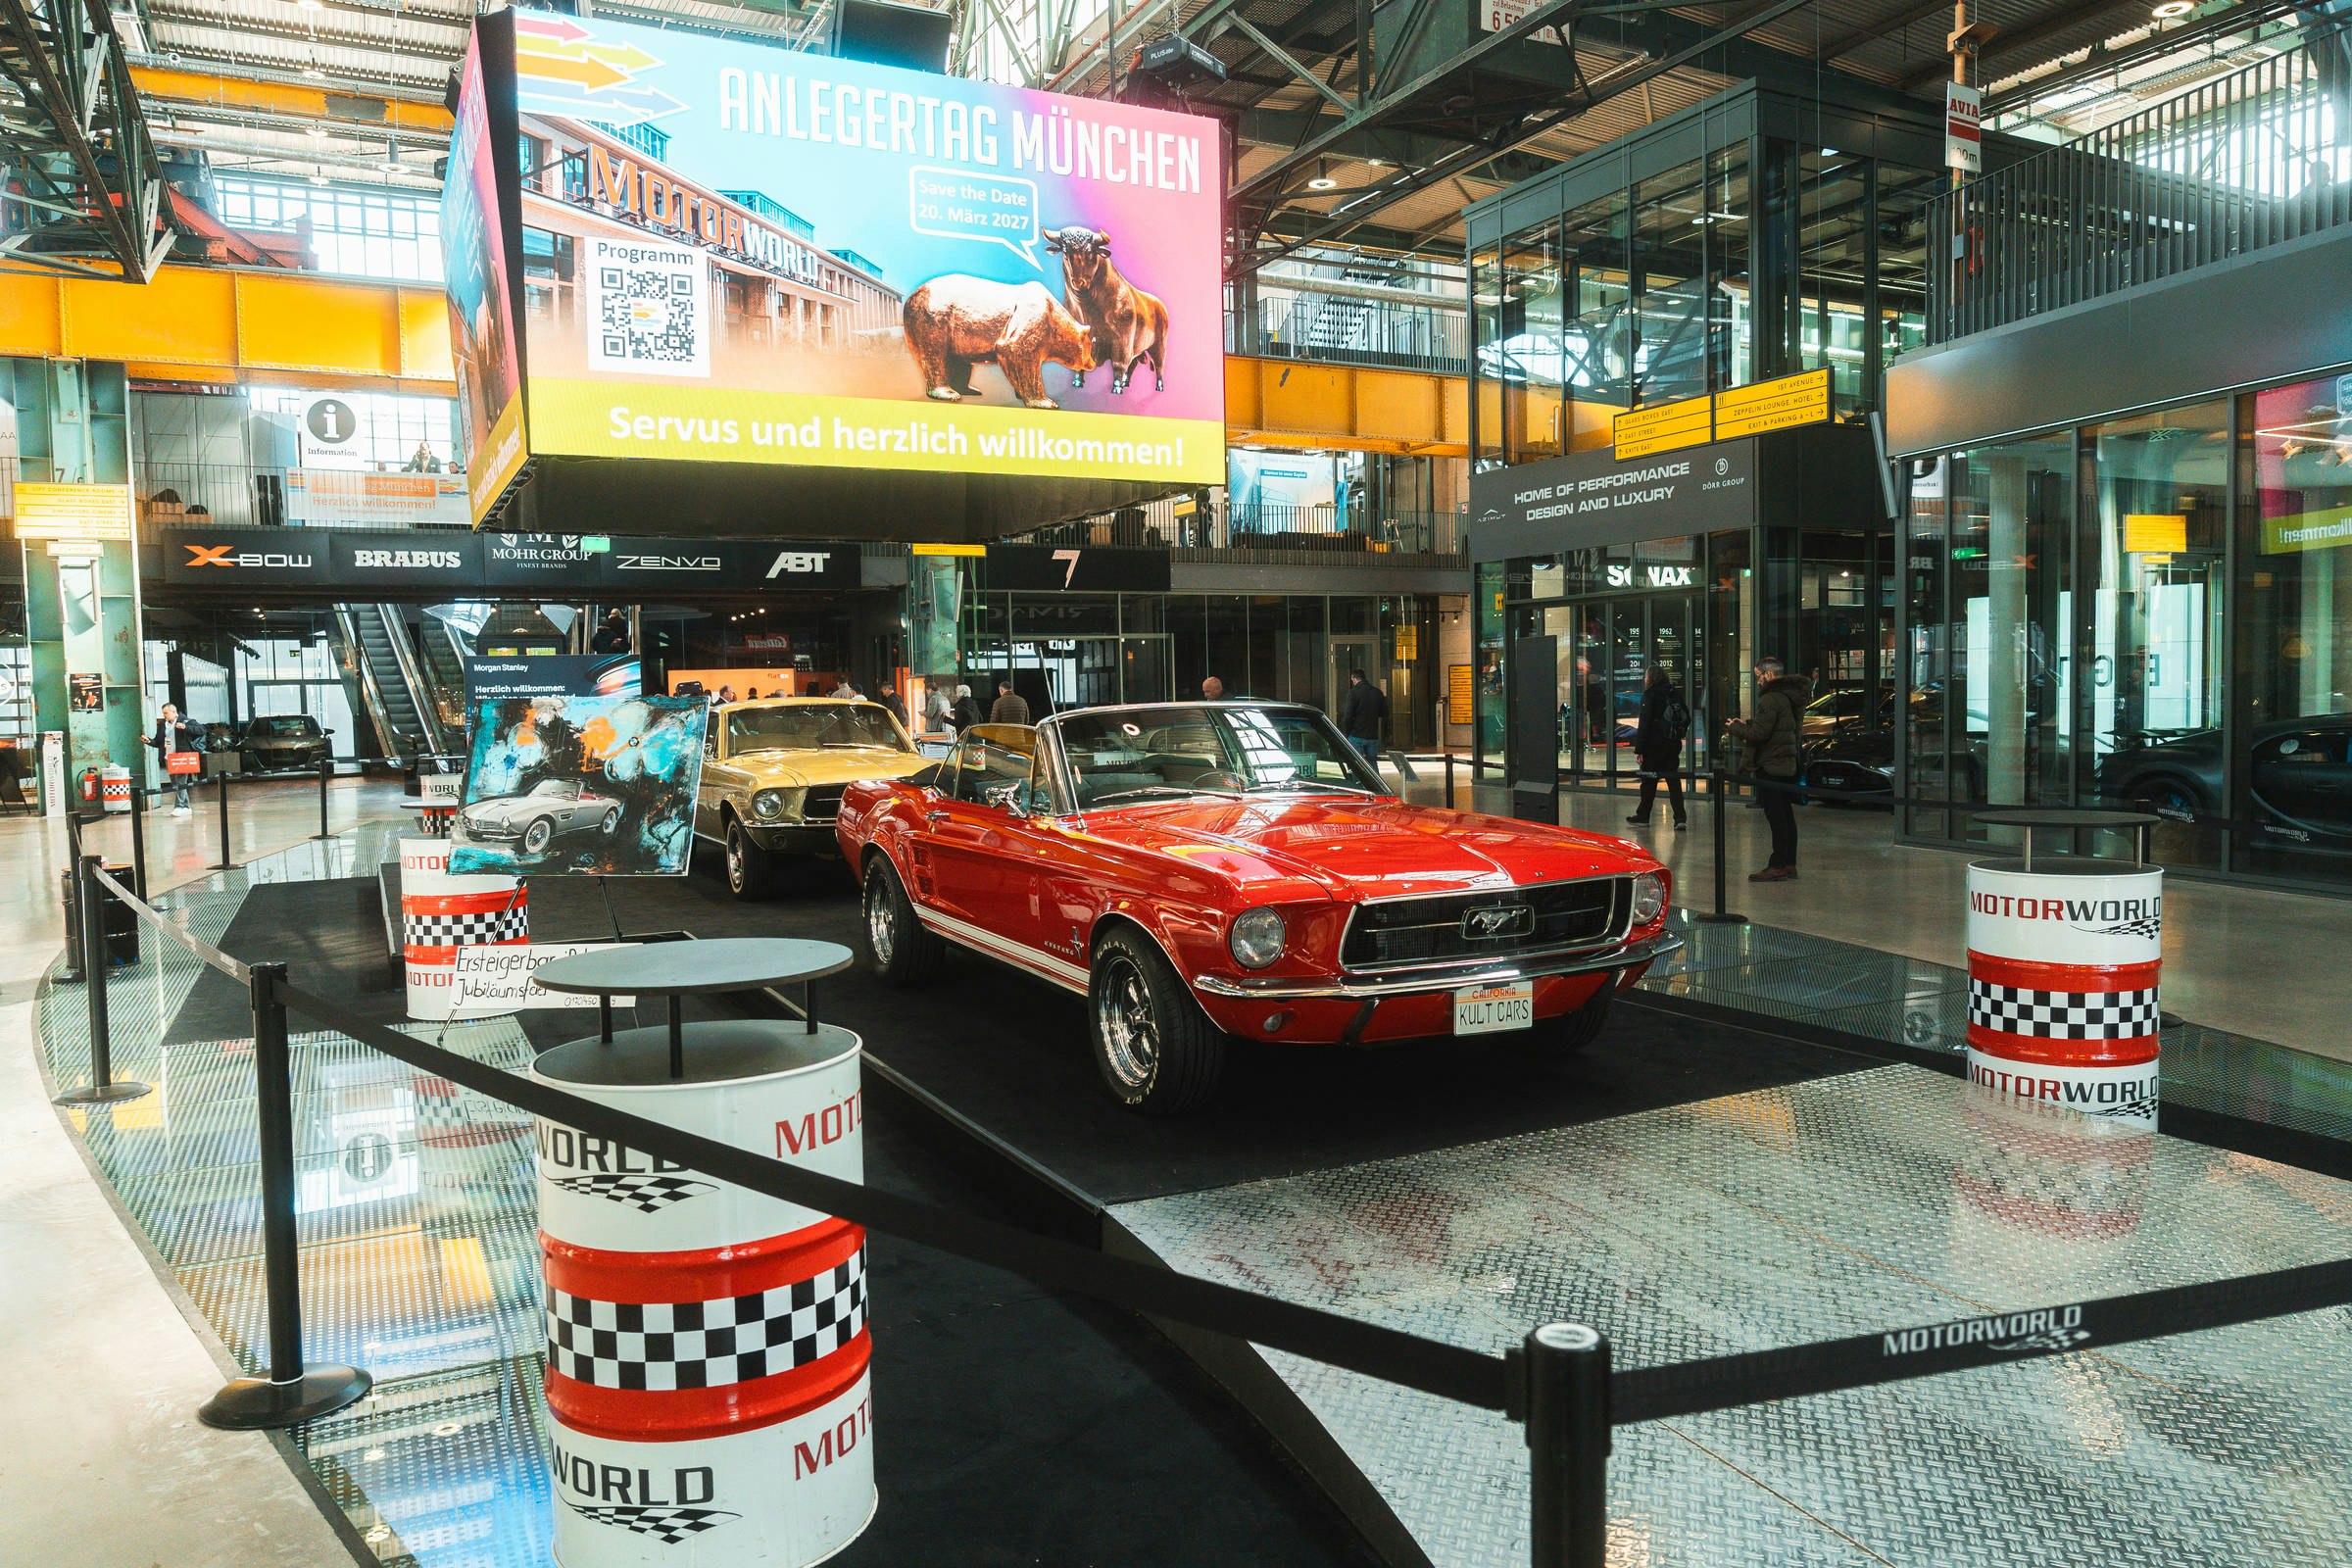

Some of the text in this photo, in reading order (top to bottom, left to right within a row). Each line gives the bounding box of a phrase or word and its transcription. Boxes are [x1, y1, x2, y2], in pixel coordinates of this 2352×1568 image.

[1949, 98, 1980, 118] AVIA
[718, 66, 1201, 194] ANLEGERTAG MÜNCHEN
[918, 178, 1028, 207] Save the Date
[588, 142, 817, 280] MOTORWORLD
[917, 203, 1030, 229] 20. März 2027
[597, 241, 694, 267] Programm
[1778, 377, 1814, 391] 1ST AVENUE
[1734, 406, 1762, 416] ZEPPELIN
[1793, 395, 1814, 405] HOTEL
[1748, 419, 1762, 430] EXIT
[1770, 413, 1797, 425] PARKING
[609, 406, 1184, 467] Servus und herzlich willkommen!
[308, 447, 358, 458] Information
[1514, 462, 1690, 505] HOME OF PERFORMANCE
[1722, 477, 1745, 487] GROUP
[312, 496, 437, 510] Herzlich willkommen!
[1526, 485, 1676, 521] DESIGN AND LUXURY
[354, 550, 462, 568] BRABUS
[492, 548, 593, 562] MOHR GROUP
[615, 555, 721, 570] ZENVO
[765, 552, 831, 578] ABT
[473, 663, 528, 673] Morgan Stanley
[474, 685, 512, 694] Herzlich
[1970, 891, 2161, 921] MOTORWORLD
[1471, 987, 1517, 1000] CALIFORNIA
[1459, 1000, 1529, 1026] KULT CARS
[1968, 1060, 2158, 1103] MOTORWORLD
[1883, 1305, 2082, 1357] MOTORWORLD
[794, 1388, 872, 1482] MOT
[550, 1436, 714, 1506] WORLD
